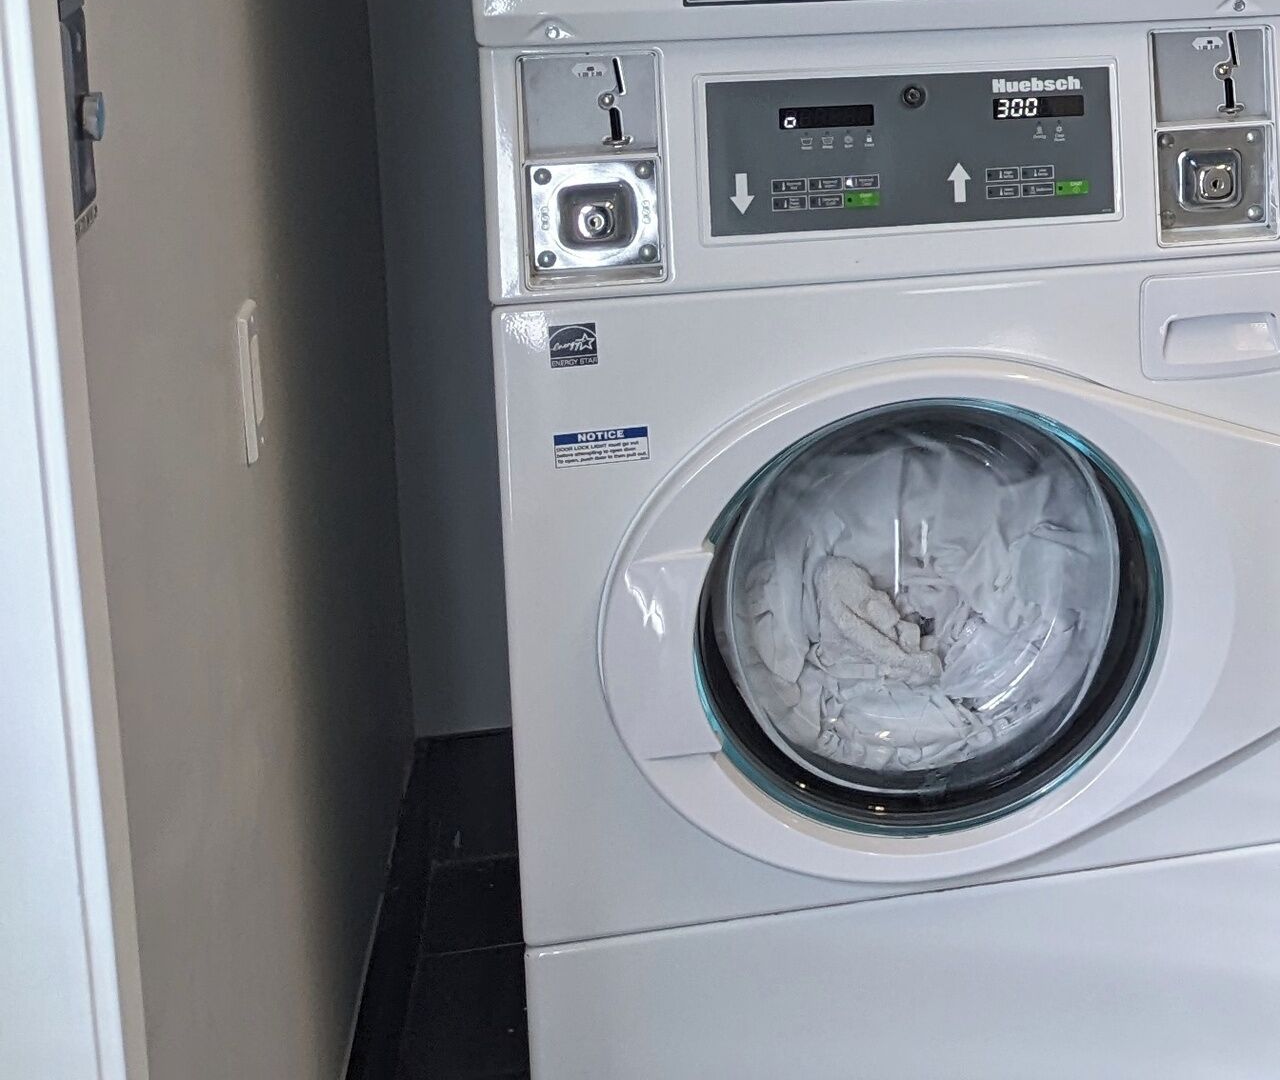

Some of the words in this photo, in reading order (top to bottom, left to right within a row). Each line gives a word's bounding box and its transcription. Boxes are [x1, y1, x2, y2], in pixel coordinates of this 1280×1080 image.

[991, 76, 1081, 94] Huebsch
[997, 98, 1038, 119] 300
[552, 359, 578, 367] ENERGY
[580, 357, 598, 365] STAR
[577, 430, 625, 442] NOTICE
